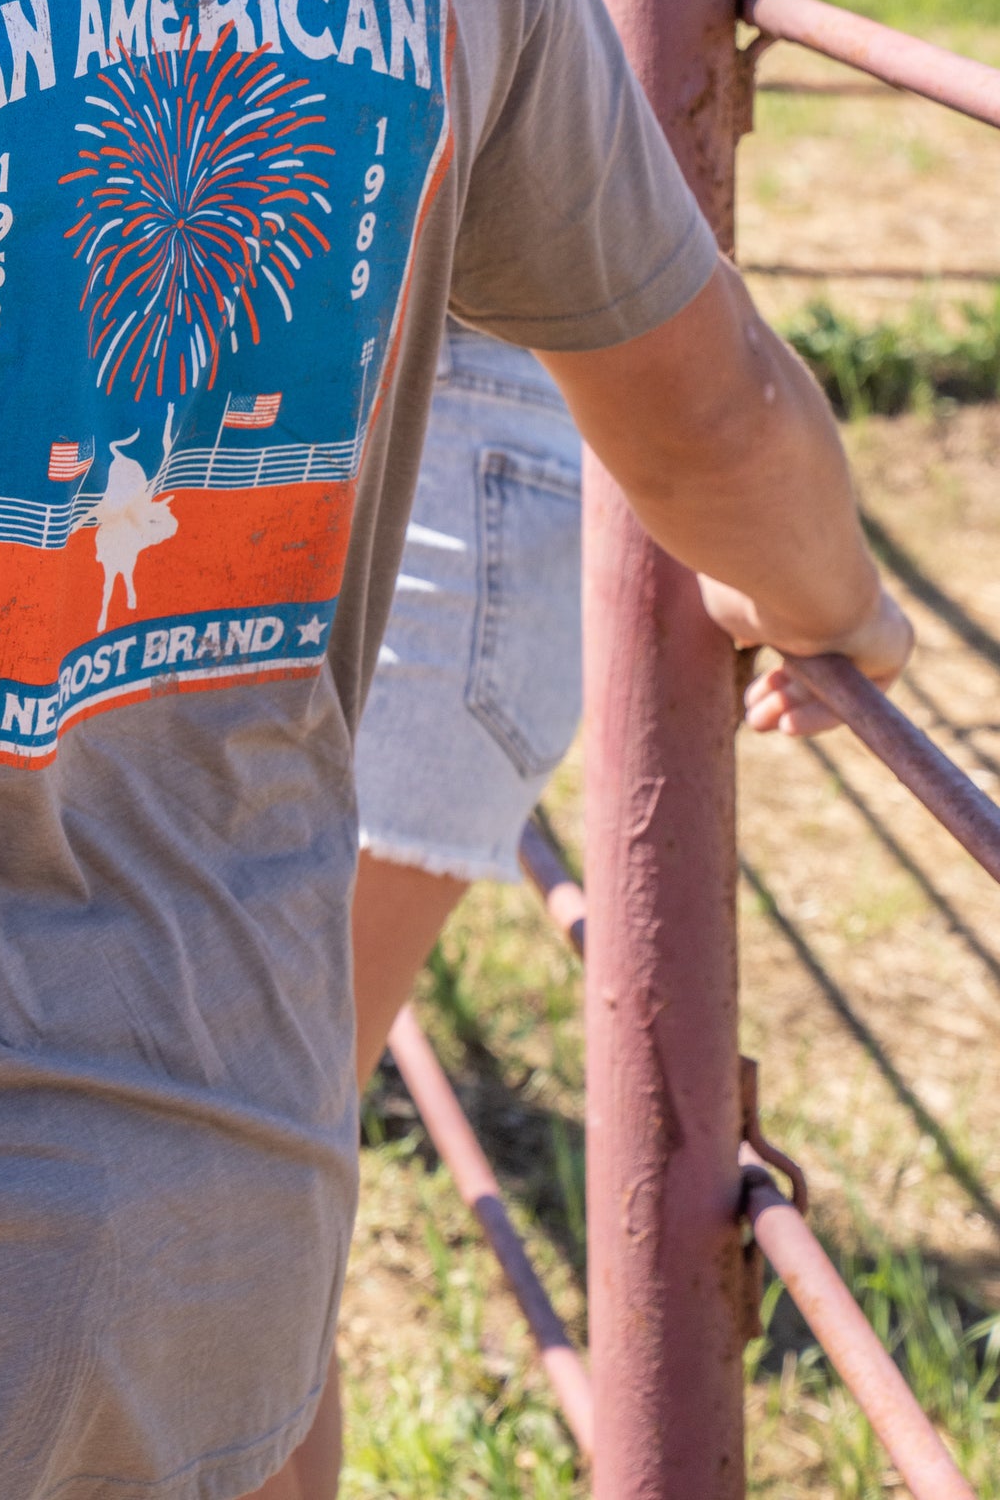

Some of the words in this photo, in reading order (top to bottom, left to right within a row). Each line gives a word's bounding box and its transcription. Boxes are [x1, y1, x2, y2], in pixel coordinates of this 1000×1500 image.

[350, 116, 388, 301] 1989
[57, 635, 137, 711] ROST
[141, 615, 285, 670] BRAND
